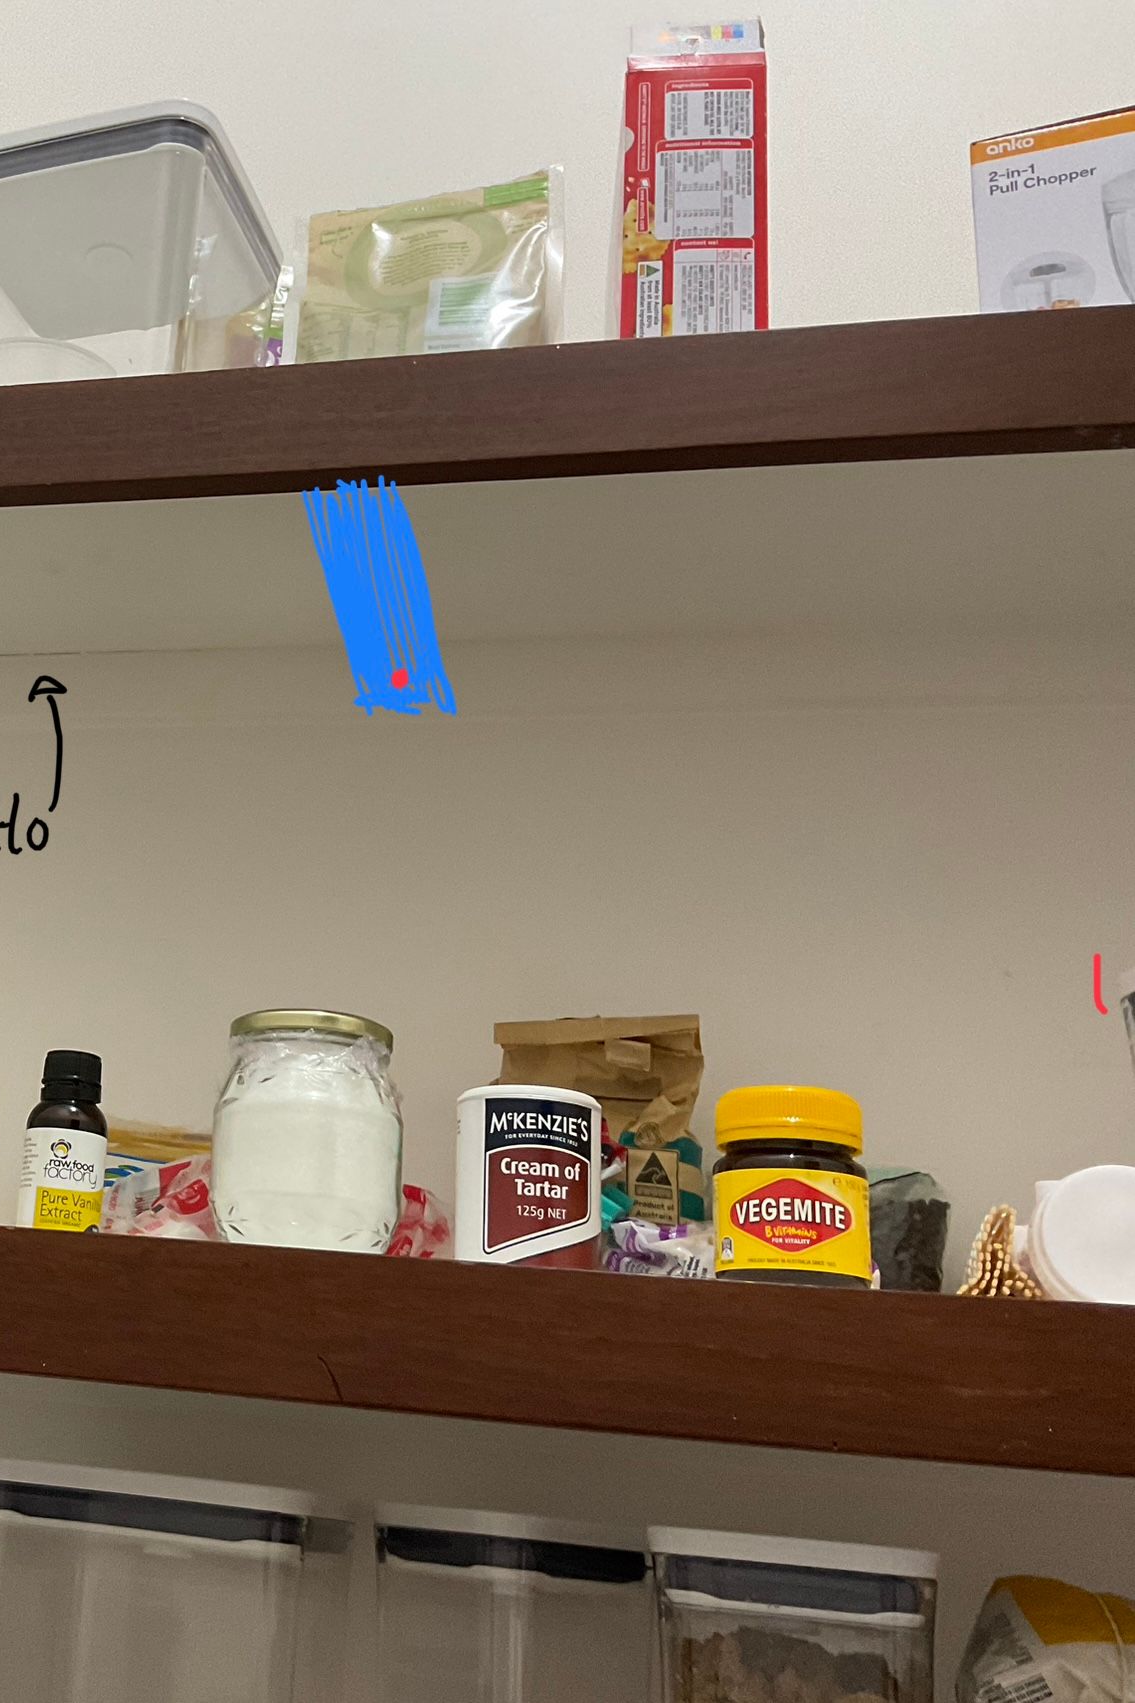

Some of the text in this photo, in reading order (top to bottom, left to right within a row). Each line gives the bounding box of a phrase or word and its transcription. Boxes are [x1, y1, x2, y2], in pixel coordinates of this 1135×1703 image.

[986, 136, 1035, 155] anko
[988, 164, 1035, 183] 2-in-1
[989, 166, 1097, 196] Pull Chopper
[489, 1112, 589, 1142] McKENZIE'S
[549, 1134, 566, 1143] SINCE
[49, 1159, 95, 1173] raw food
[500, 1157, 581, 1181] Cream of
[43, 1163, 97, 1189] factory
[41, 1190, 68, 1205] Pure
[515, 1178, 569, 1200] Tartar
[40, 1204, 82, 1221] Extract
[516, 1205, 567, 1220] 125g NET
[734, 1197, 846, 1230] VEGEMITE
[764, 1225, 773, 1238] B
[784, 1237, 811, 1245] VITALITY
